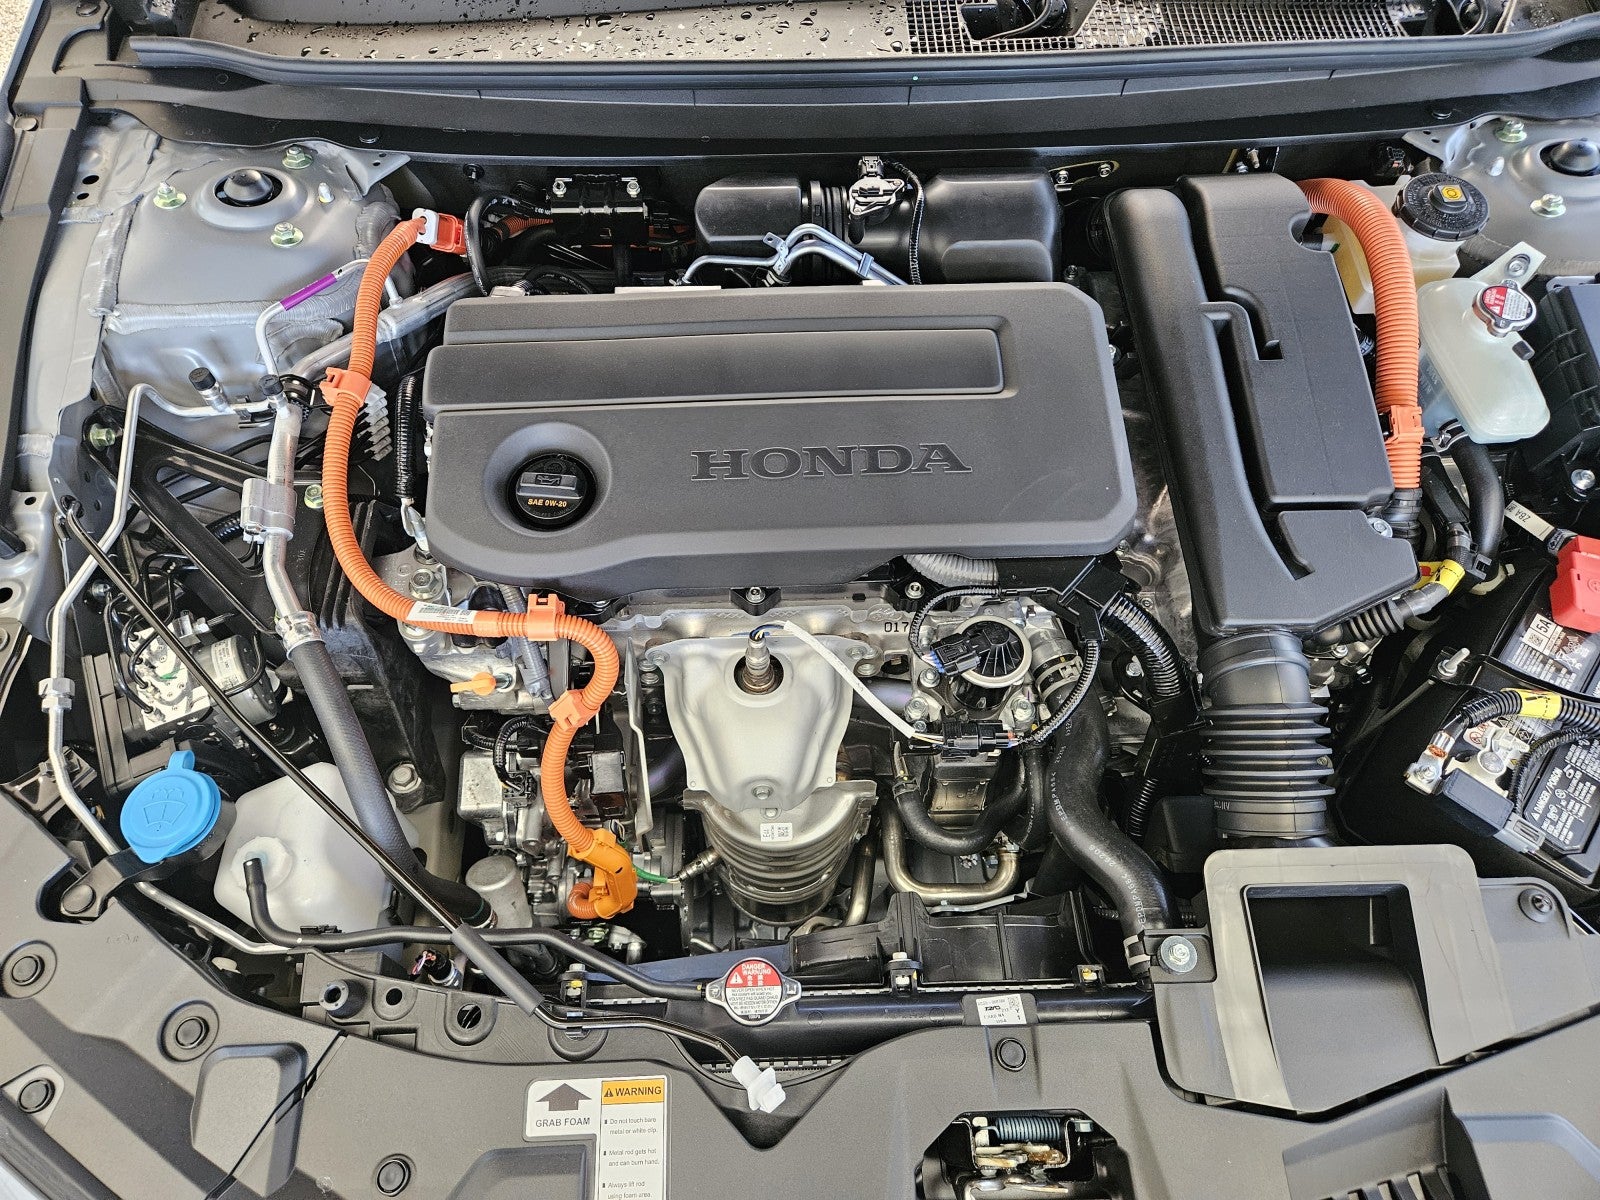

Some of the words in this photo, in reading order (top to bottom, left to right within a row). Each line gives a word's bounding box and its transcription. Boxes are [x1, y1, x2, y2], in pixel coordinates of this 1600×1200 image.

[690, 443, 972, 481] HONDA
[528, 498, 543, 506] SAE
[545, 499, 567, 507] 0W-20
[884, 621, 909, 633] 017
[1536, 619, 1551, 633] 5A
[615, 1086, 662, 1097] WARNING
[535, 1118, 562, 1128] GRAB
[564, 1117, 590, 1126] FOAM
[635, 1148, 647, 1156] gets
[607, 1181, 627, 1189] Always
[607, 1192, 623, 1200] using
